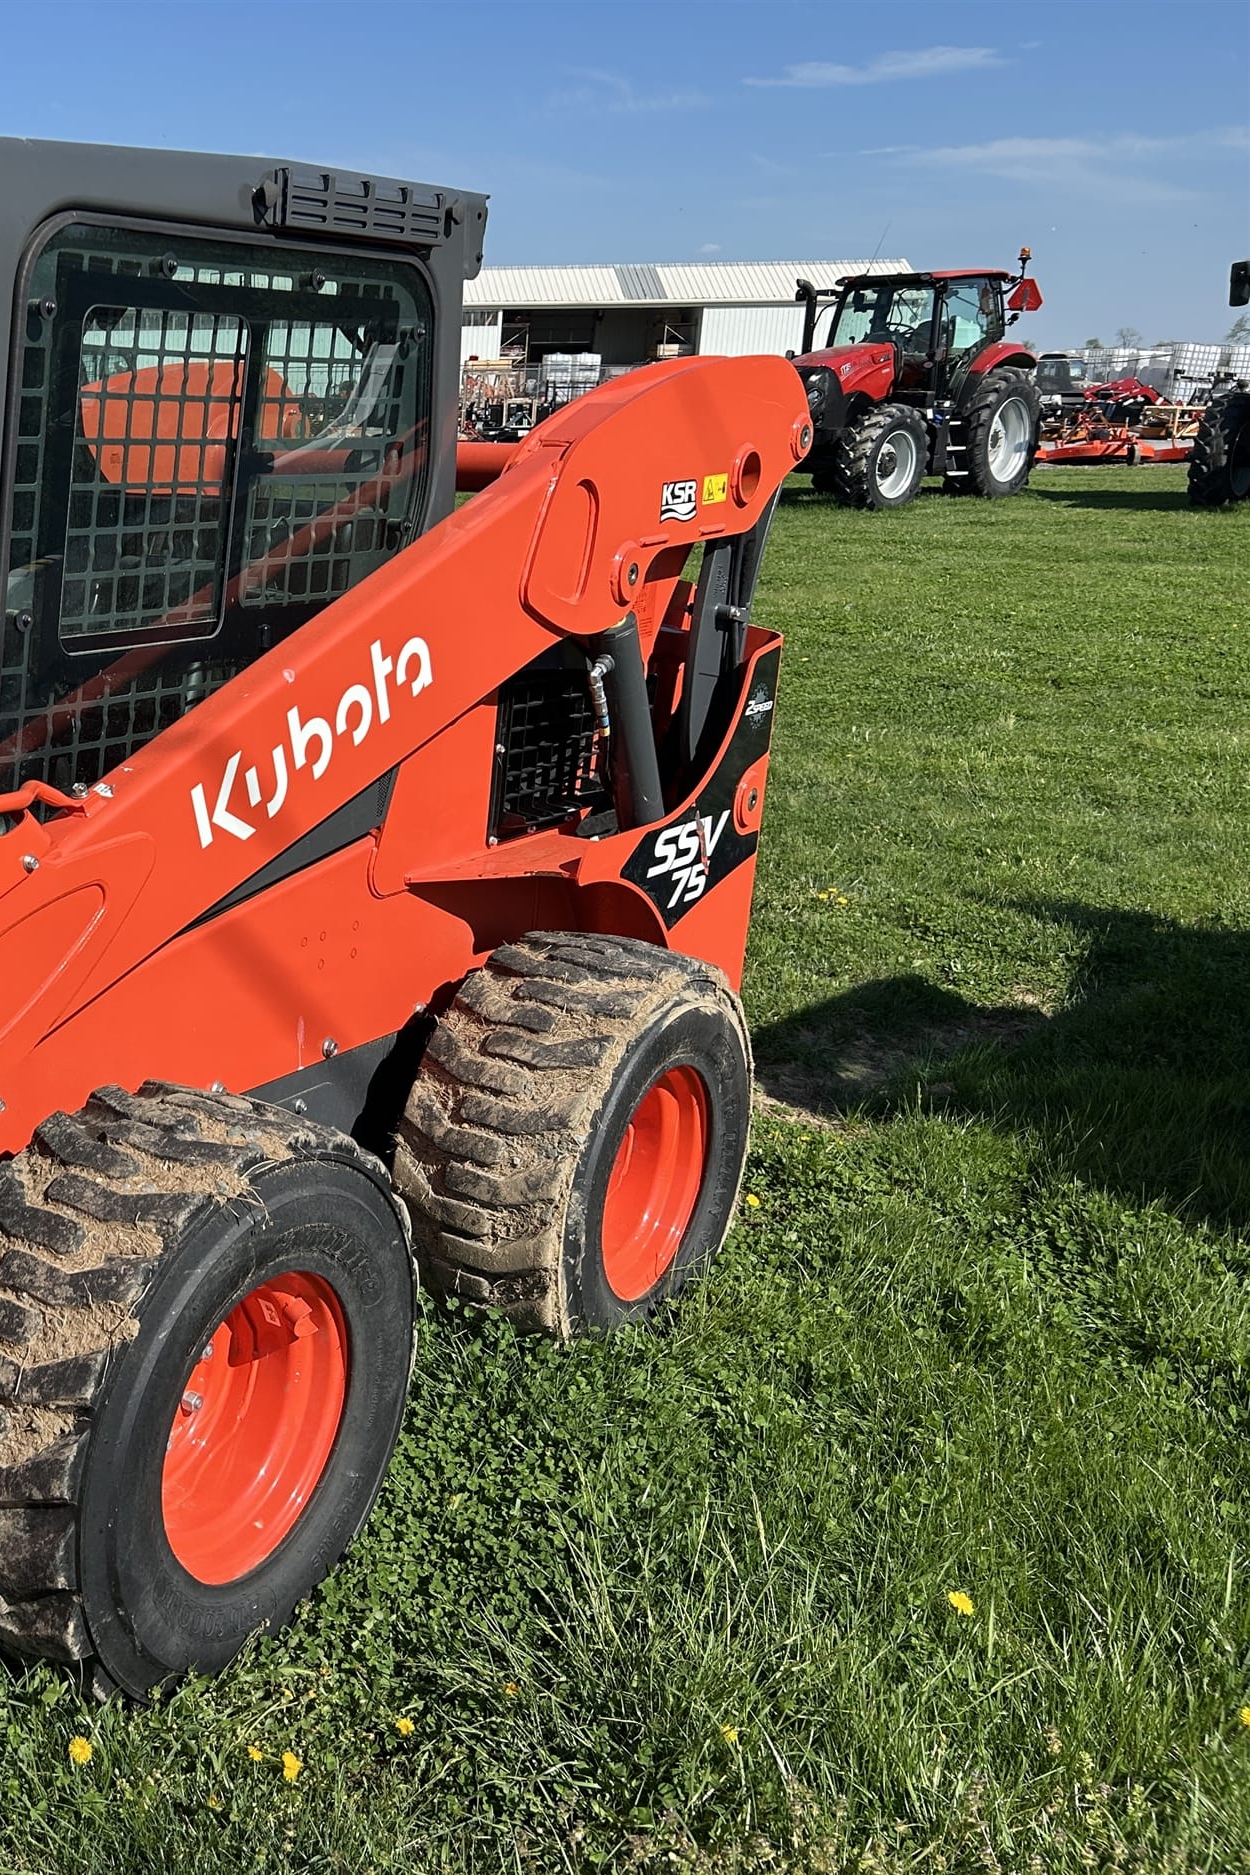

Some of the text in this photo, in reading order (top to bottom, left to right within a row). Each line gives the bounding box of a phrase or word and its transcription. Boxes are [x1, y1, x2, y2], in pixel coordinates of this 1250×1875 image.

[662, 481, 697, 506] KSR
[190, 637, 433, 849] Kubota
[646, 809, 731, 878] SSV
[667, 861, 710, 909] 75
